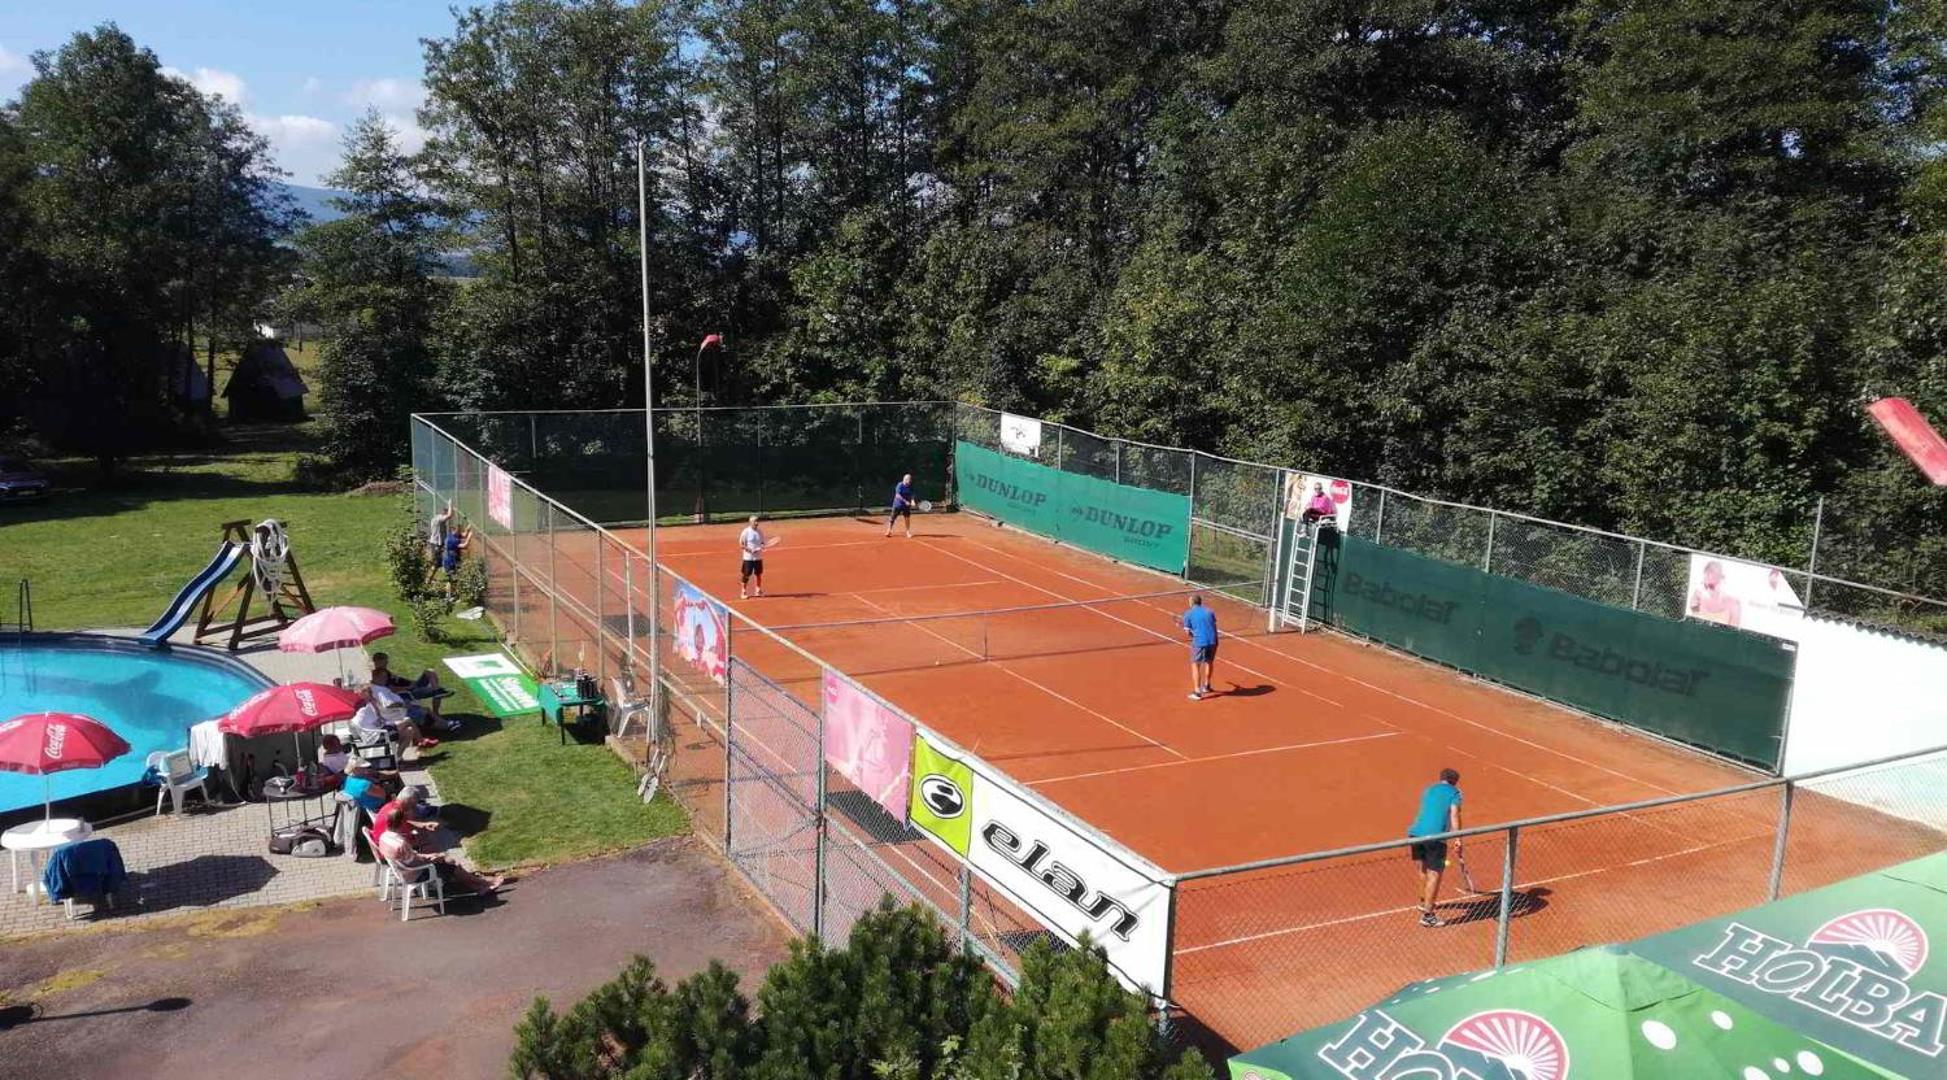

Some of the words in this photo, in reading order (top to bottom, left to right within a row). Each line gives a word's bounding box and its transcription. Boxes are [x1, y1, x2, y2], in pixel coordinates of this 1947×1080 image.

[976, 473, 1048, 508] DUNLOP
[1084, 506, 1174, 539] DUNLOP
[1551, 631, 1712, 697] Babolat
[981, 819, 1141, 942] elan
[1692, 921, 1947, 1058] HOLBA
